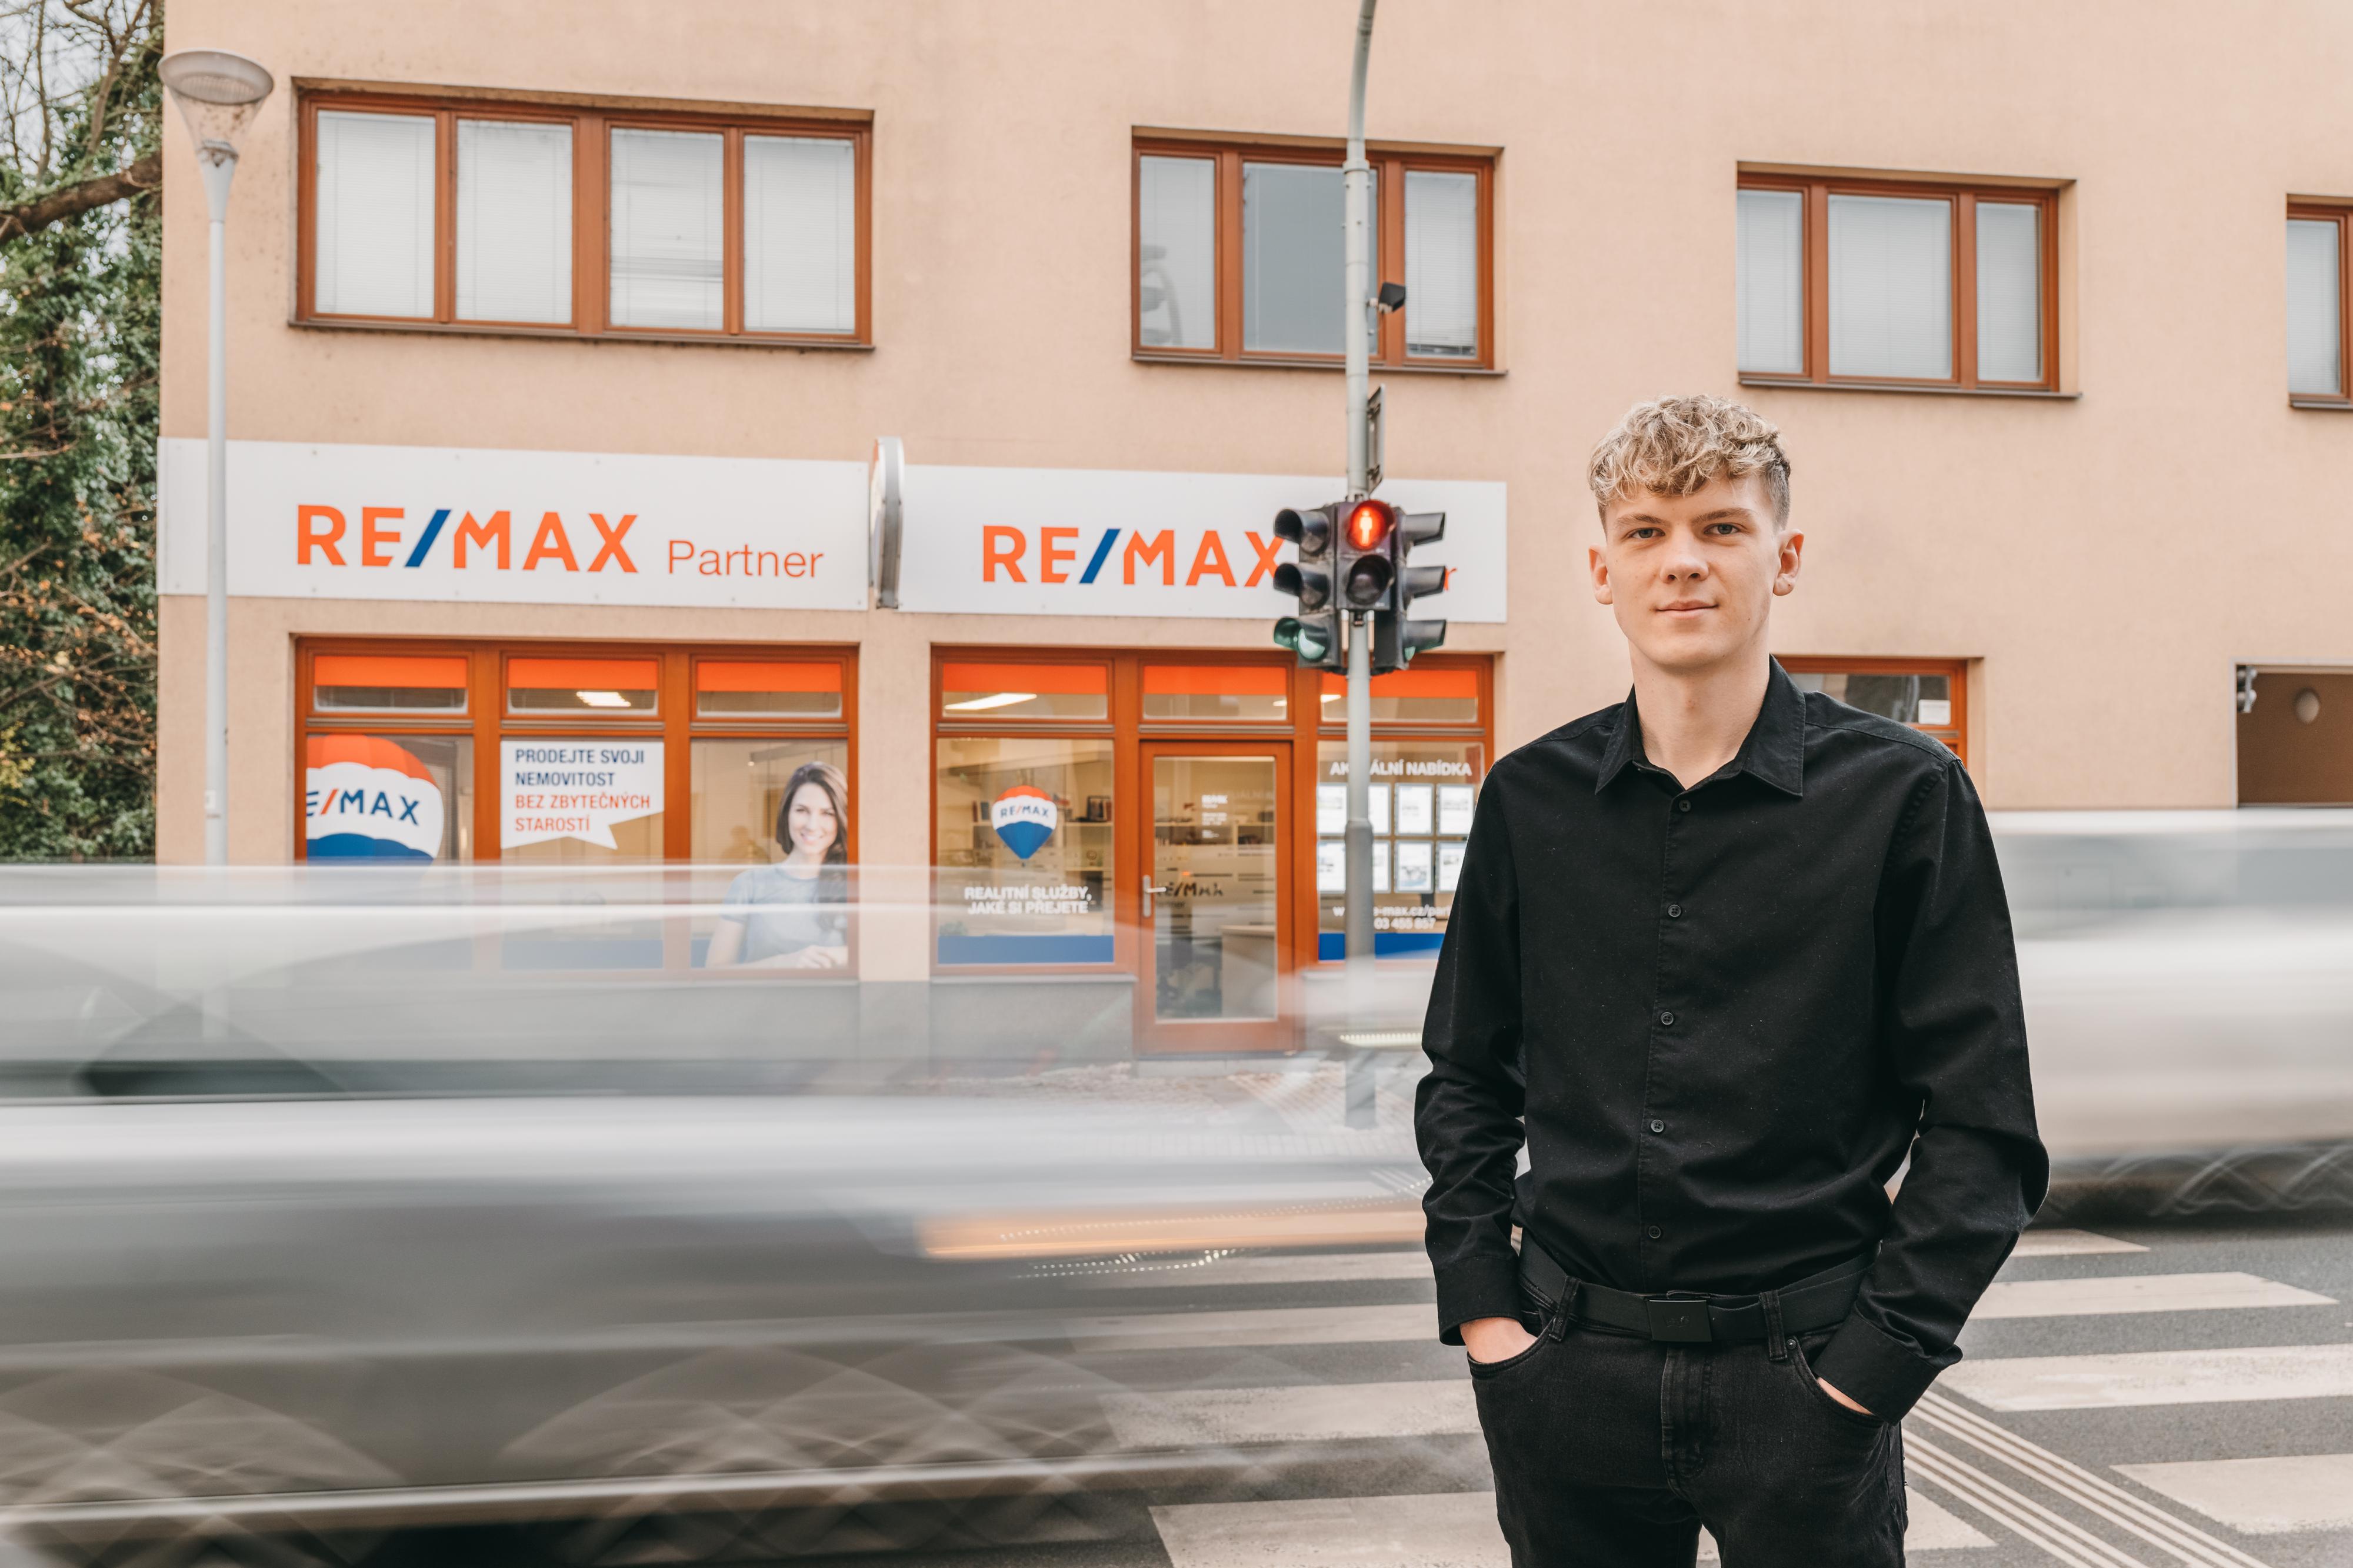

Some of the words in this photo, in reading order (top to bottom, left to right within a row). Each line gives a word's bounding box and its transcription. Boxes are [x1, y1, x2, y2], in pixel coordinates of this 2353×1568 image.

[296, 503, 638, 574] RE/MAX
[668, 539, 824, 578] Partner
[982, 524, 1285, 588] RE/MAX
[515, 749, 595, 764] PRODEJTE
[600, 749, 645, 765] SVOJI
[1330, 759, 1404, 776] AKÁLNÍ
[1407, 759, 1472, 776] NABÍDKA
[515, 772, 615, 787] NEMOVITOST
[515, 795, 546, 809] BEZ
[550, 792, 650, 810] ZBYTEČNÝCH
[1001, 805, 1049, 818] RE/MAX
[515, 815, 590, 832] STAROSTÍ
[965, 884, 1029, 900] REALITNÍ
[1032, 884, 1092, 901] SLUŽBY,
[968, 899, 1005, 914] JAKÉ
[1008, 901, 1022, 914] SI
[1025, 899, 1088, 914] PŘEJETE
